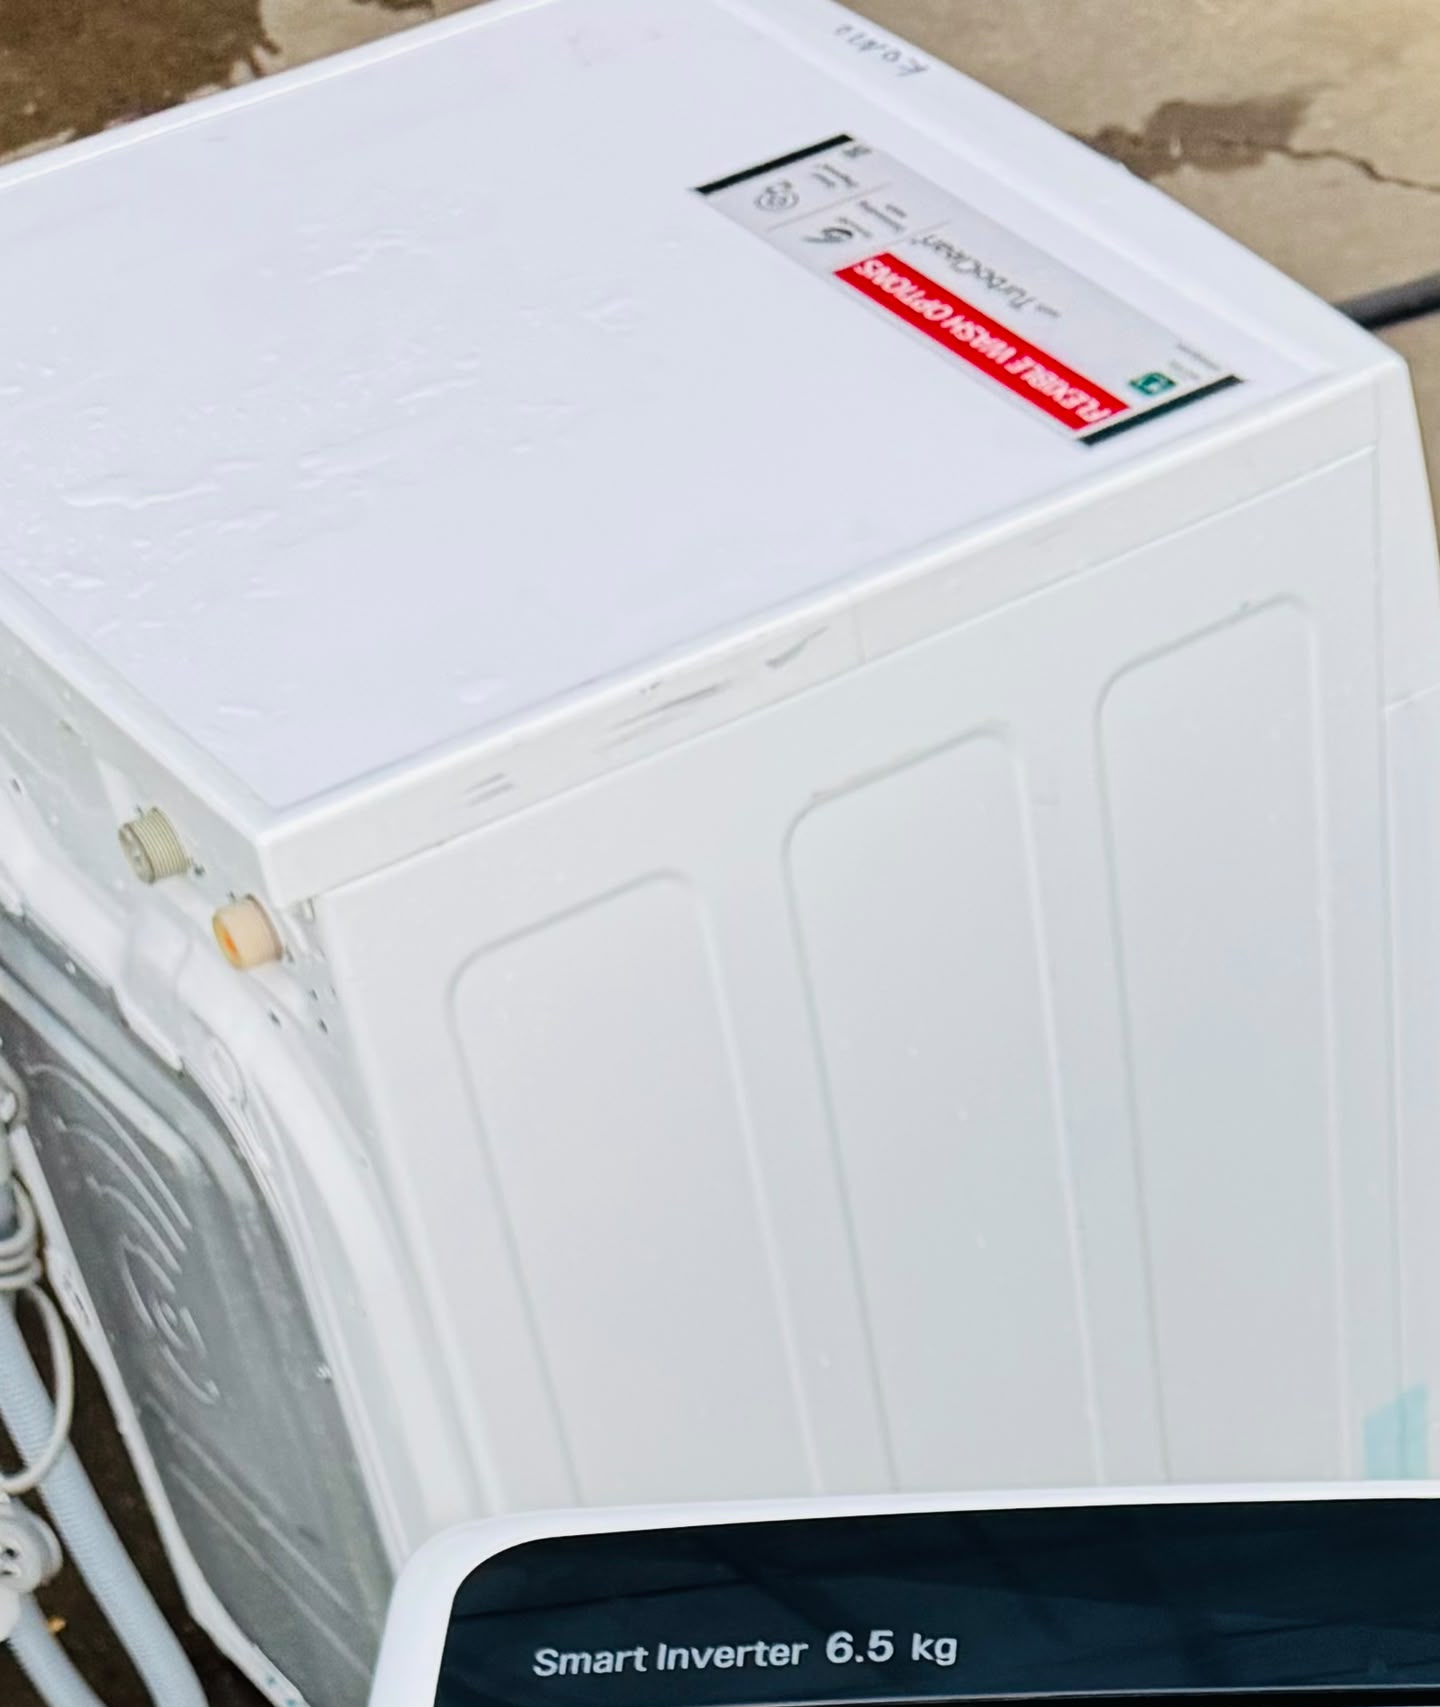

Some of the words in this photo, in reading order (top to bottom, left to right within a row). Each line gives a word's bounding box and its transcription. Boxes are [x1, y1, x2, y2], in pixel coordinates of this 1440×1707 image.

[853, 258, 953, 322] OPTIONS
[947, 313, 1018, 365] WASH
[1005, 355, 1111, 422] FLEXIBLE
[533, 1644, 648, 1677] Smart
[657, 1639, 809, 1672] Inverter
[825, 1629, 895, 1664] 6.5
[911, 1632, 958, 1667] kg
